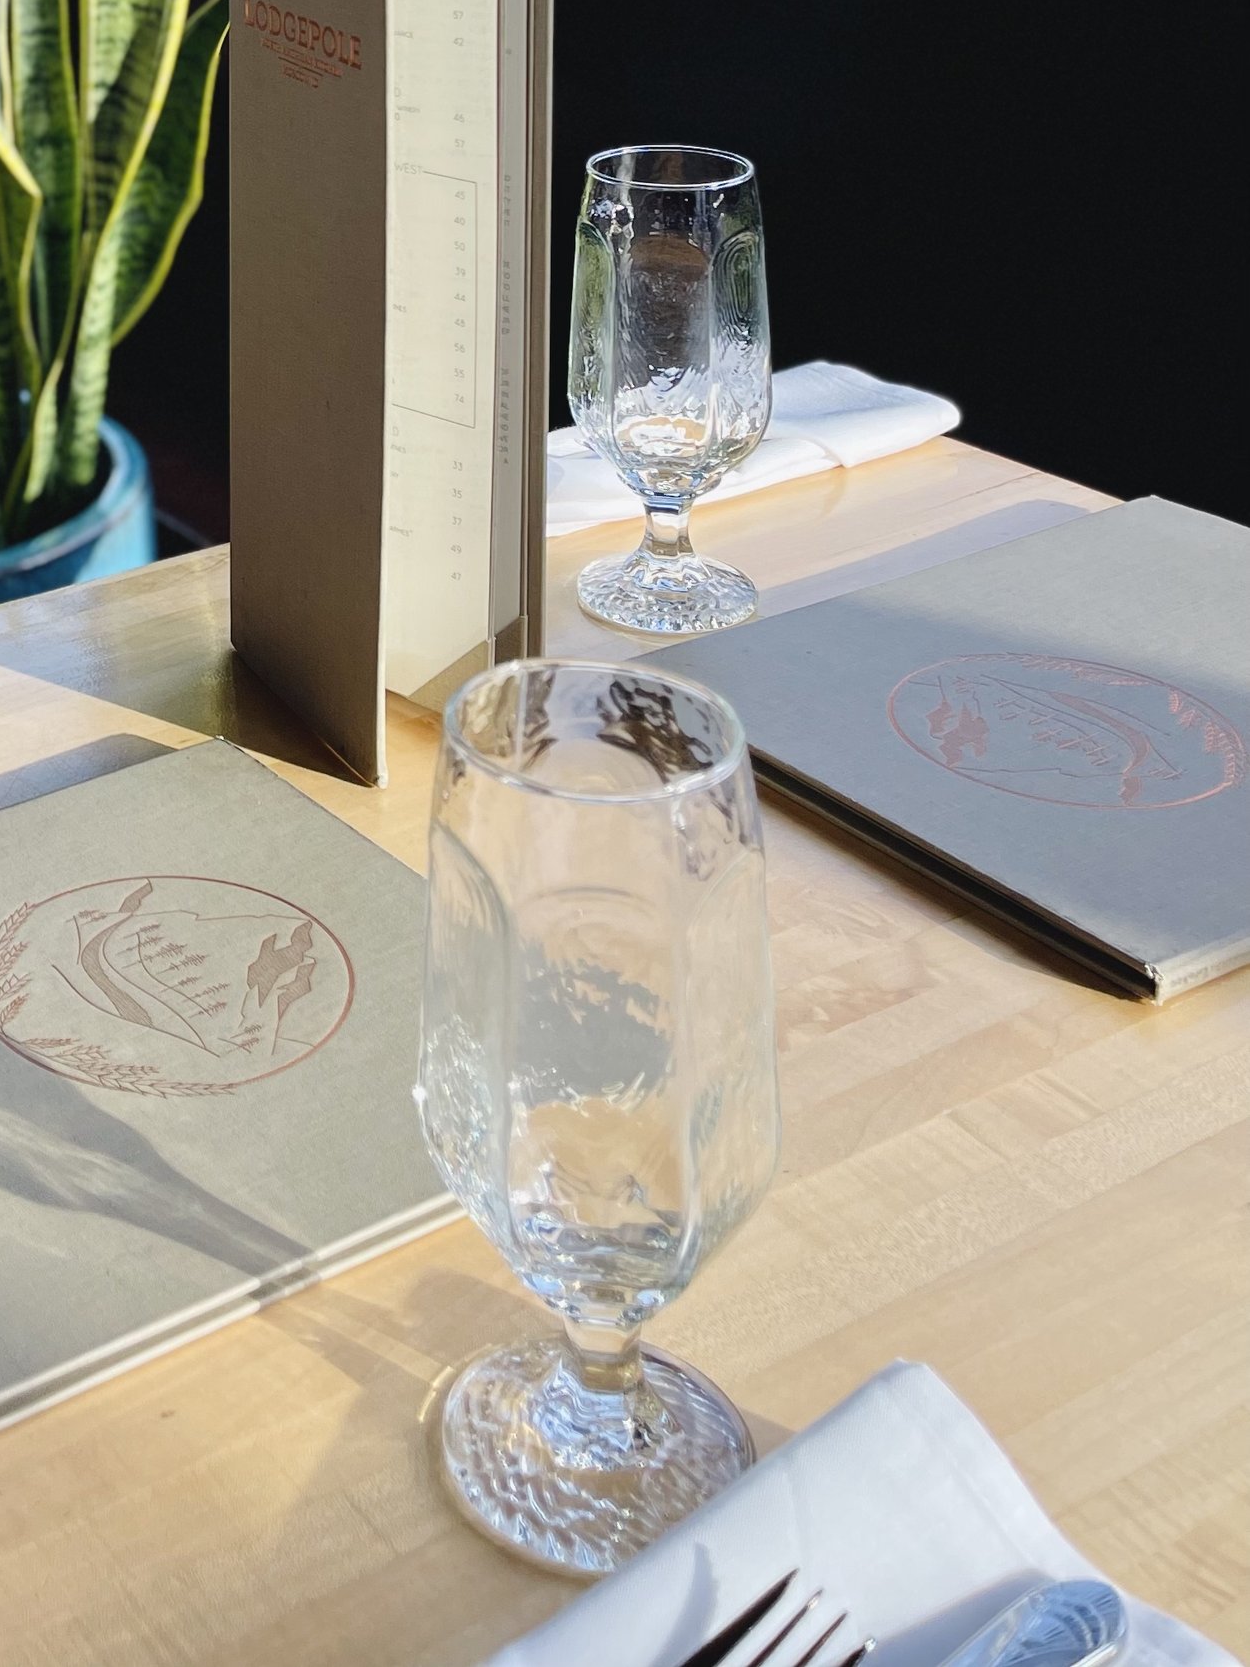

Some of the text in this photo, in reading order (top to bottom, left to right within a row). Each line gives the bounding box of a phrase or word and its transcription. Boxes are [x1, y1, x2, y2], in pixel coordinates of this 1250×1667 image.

[394, 161, 423, 175] WEST
[452, 460, 463, 472] 33
[451, 488, 463, 499] 35
[451, 516, 463, 527] 37
[450, 571, 462, 581] 47
